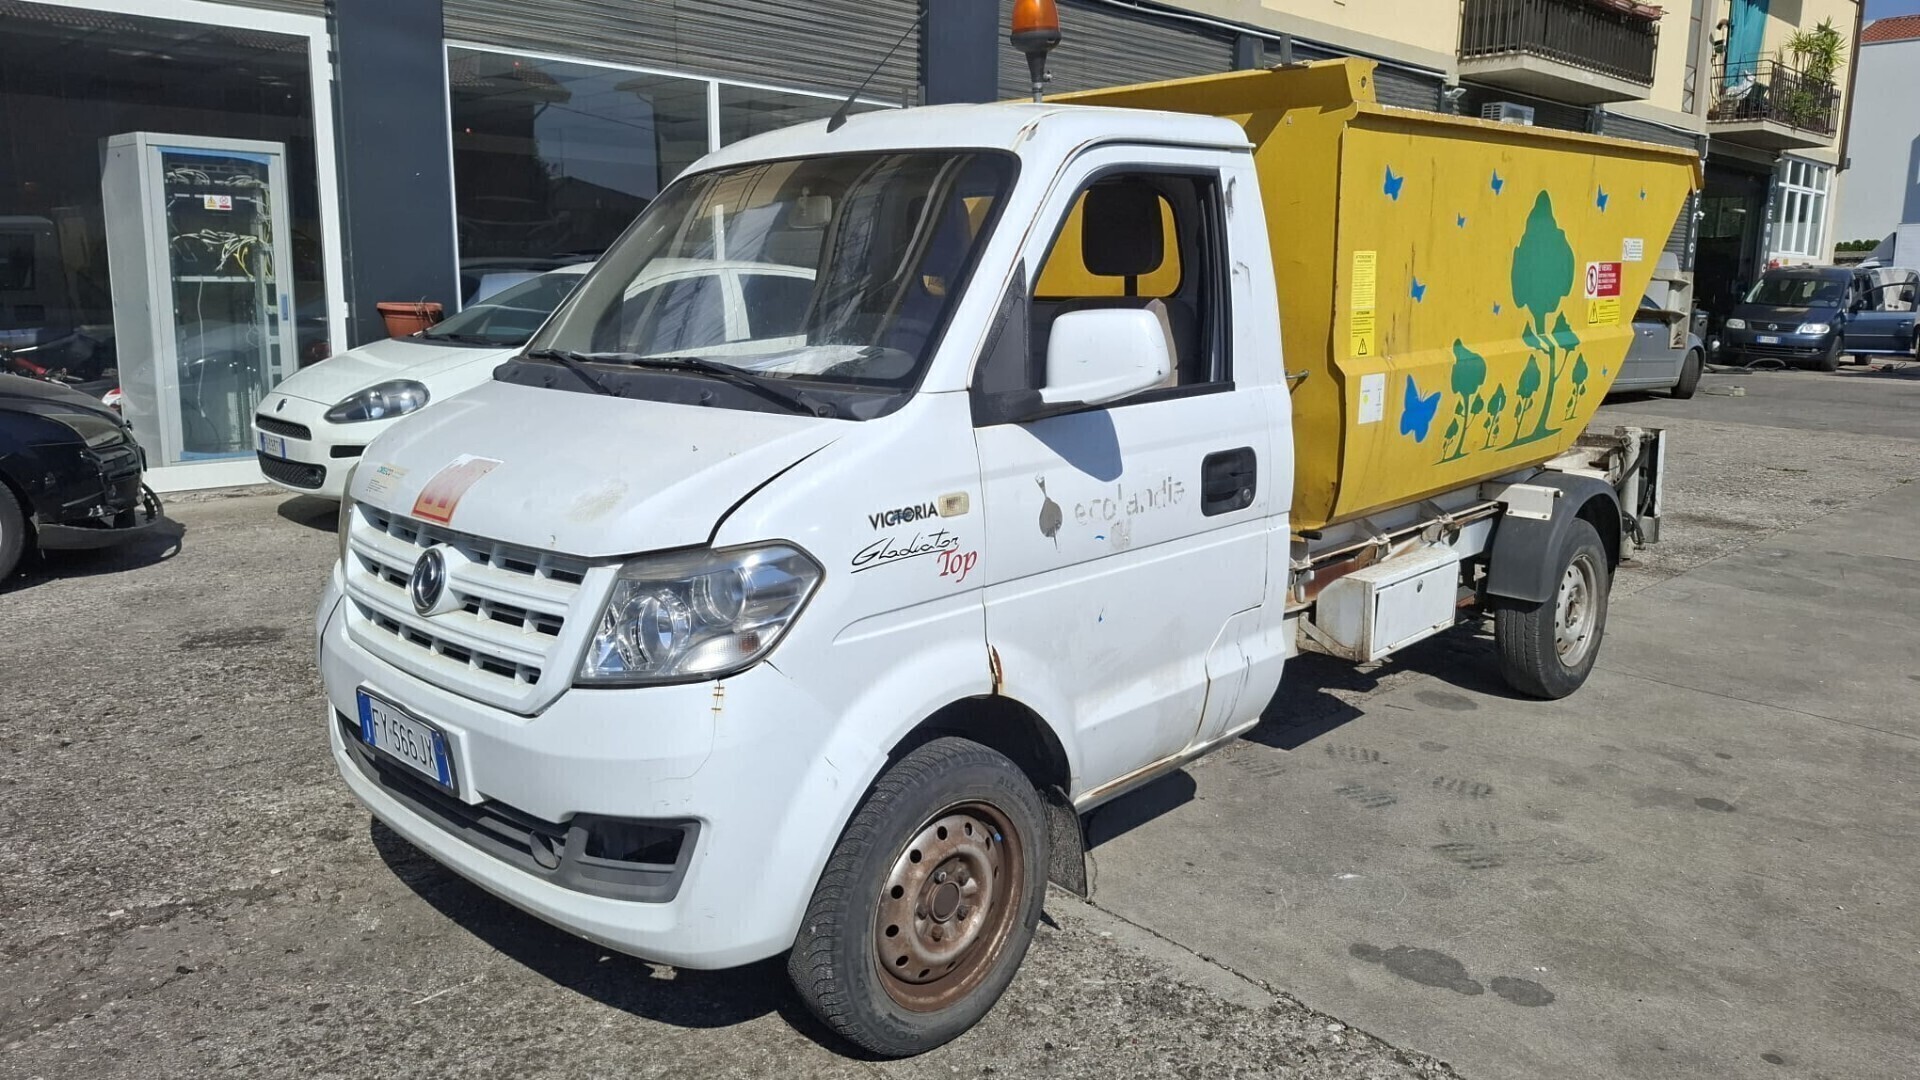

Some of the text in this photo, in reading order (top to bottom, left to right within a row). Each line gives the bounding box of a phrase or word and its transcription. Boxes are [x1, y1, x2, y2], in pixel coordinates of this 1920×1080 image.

[868, 501, 938, 531] VICTORIA
[851, 528, 960, 568] Gladiator
[937, 547, 978, 583] Top
[391, 719, 419, 761] 566
